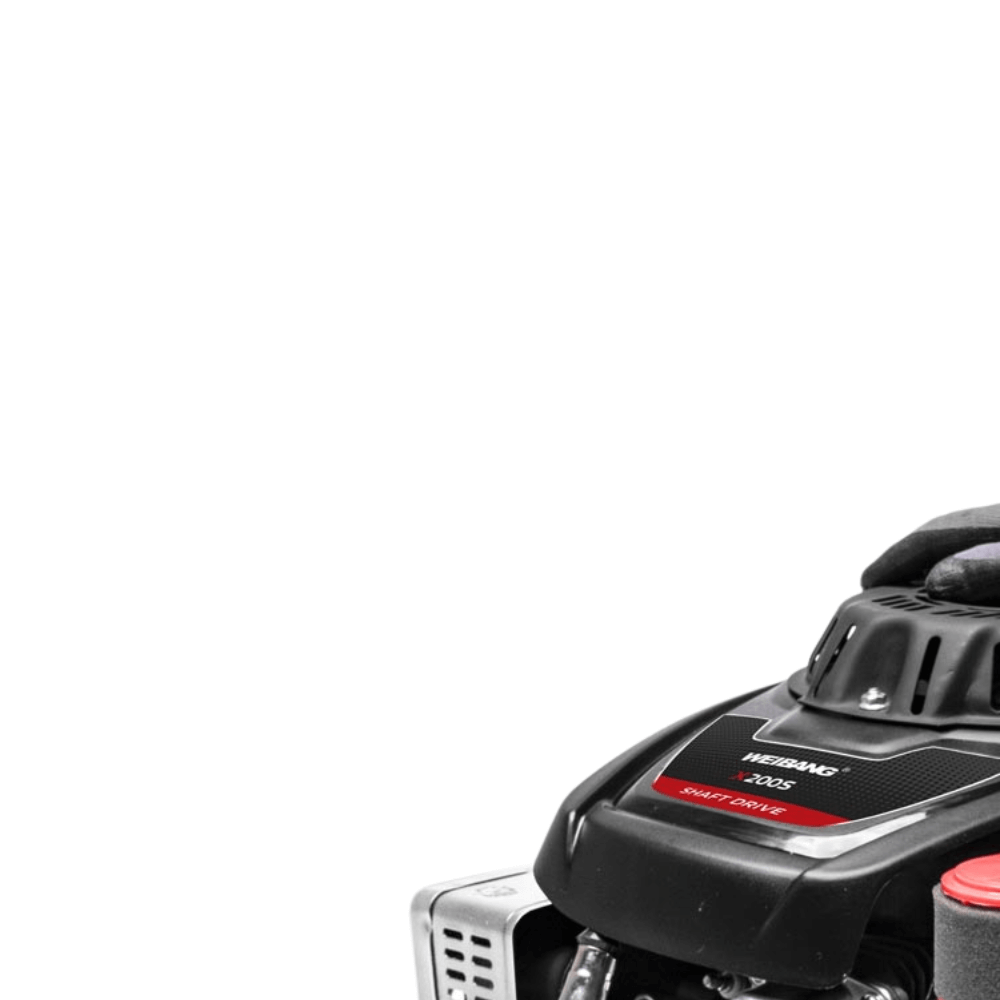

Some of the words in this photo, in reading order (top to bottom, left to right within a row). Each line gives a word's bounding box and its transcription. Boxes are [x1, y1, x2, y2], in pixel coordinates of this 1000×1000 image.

[729, 771, 797, 791] X200S
[680, 786, 732, 802] SHAFT
[729, 797, 787, 816] DRIVE
